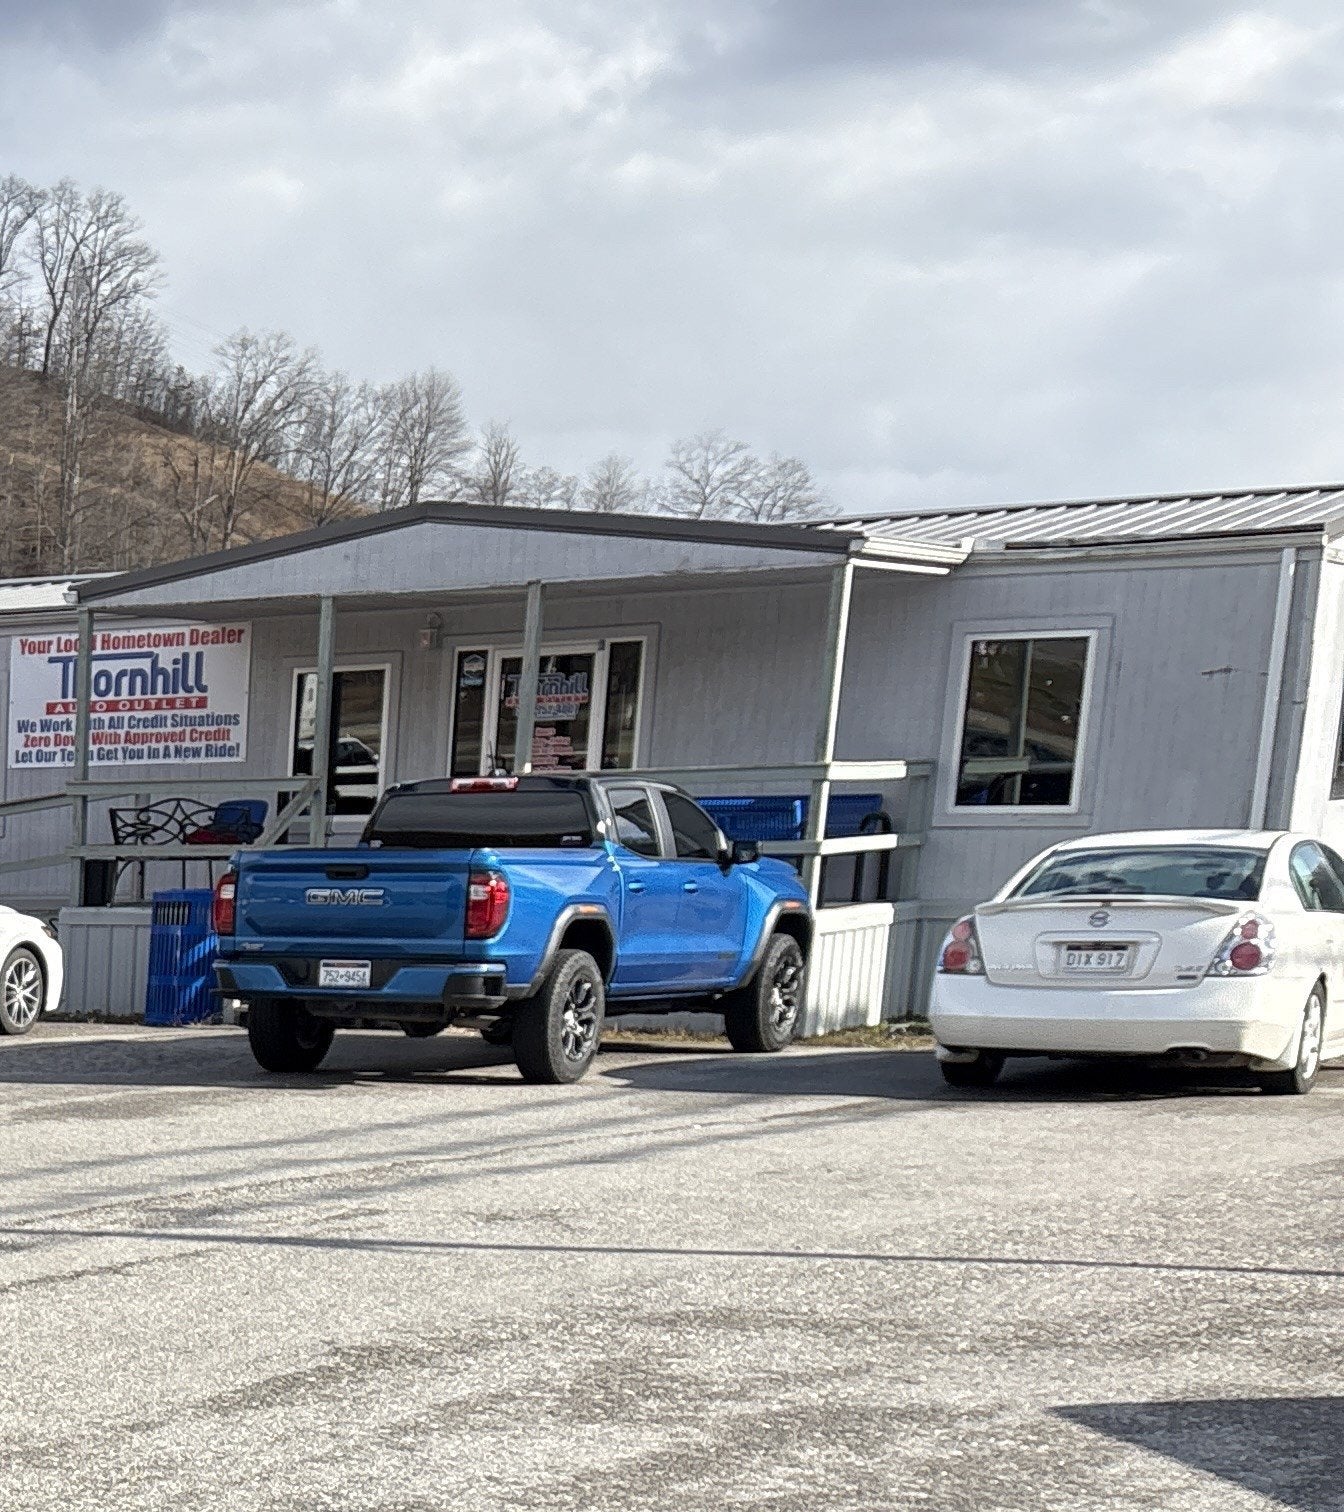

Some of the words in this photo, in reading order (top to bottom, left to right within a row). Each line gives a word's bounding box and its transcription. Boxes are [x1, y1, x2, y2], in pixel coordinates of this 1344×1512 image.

[20, 638, 53, 655] Your
[56, 634, 98, 653] Locl
[101, 631, 186, 650] Hometown
[189, 627, 244, 646] Dealer
[118, 698, 200, 711] OUTLET
[17, 719, 37, 733] We
[40, 718, 73, 732] Work
[108, 716, 124, 730] All
[127, 714, 168, 729] Credit
[170, 713, 241, 728] Situations
[24, 734, 51, 748] Zero
[91, 731, 121, 746] With
[123, 729, 186, 745] Approved
[189, 728, 231, 742] Credit
[15, 750, 33, 764] Let
[35, 749, 58, 763] Our
[97, 747, 119, 761] Get
[121, 745, 144, 760] You
[147, 745, 160, 759] In
[162, 745, 172, 759] A
[174, 744, 202, 758] New
[204, 742, 241, 758] Ride!
[305, 889, 385, 906] GMC
[1097, 952, 1125, 966] 917
